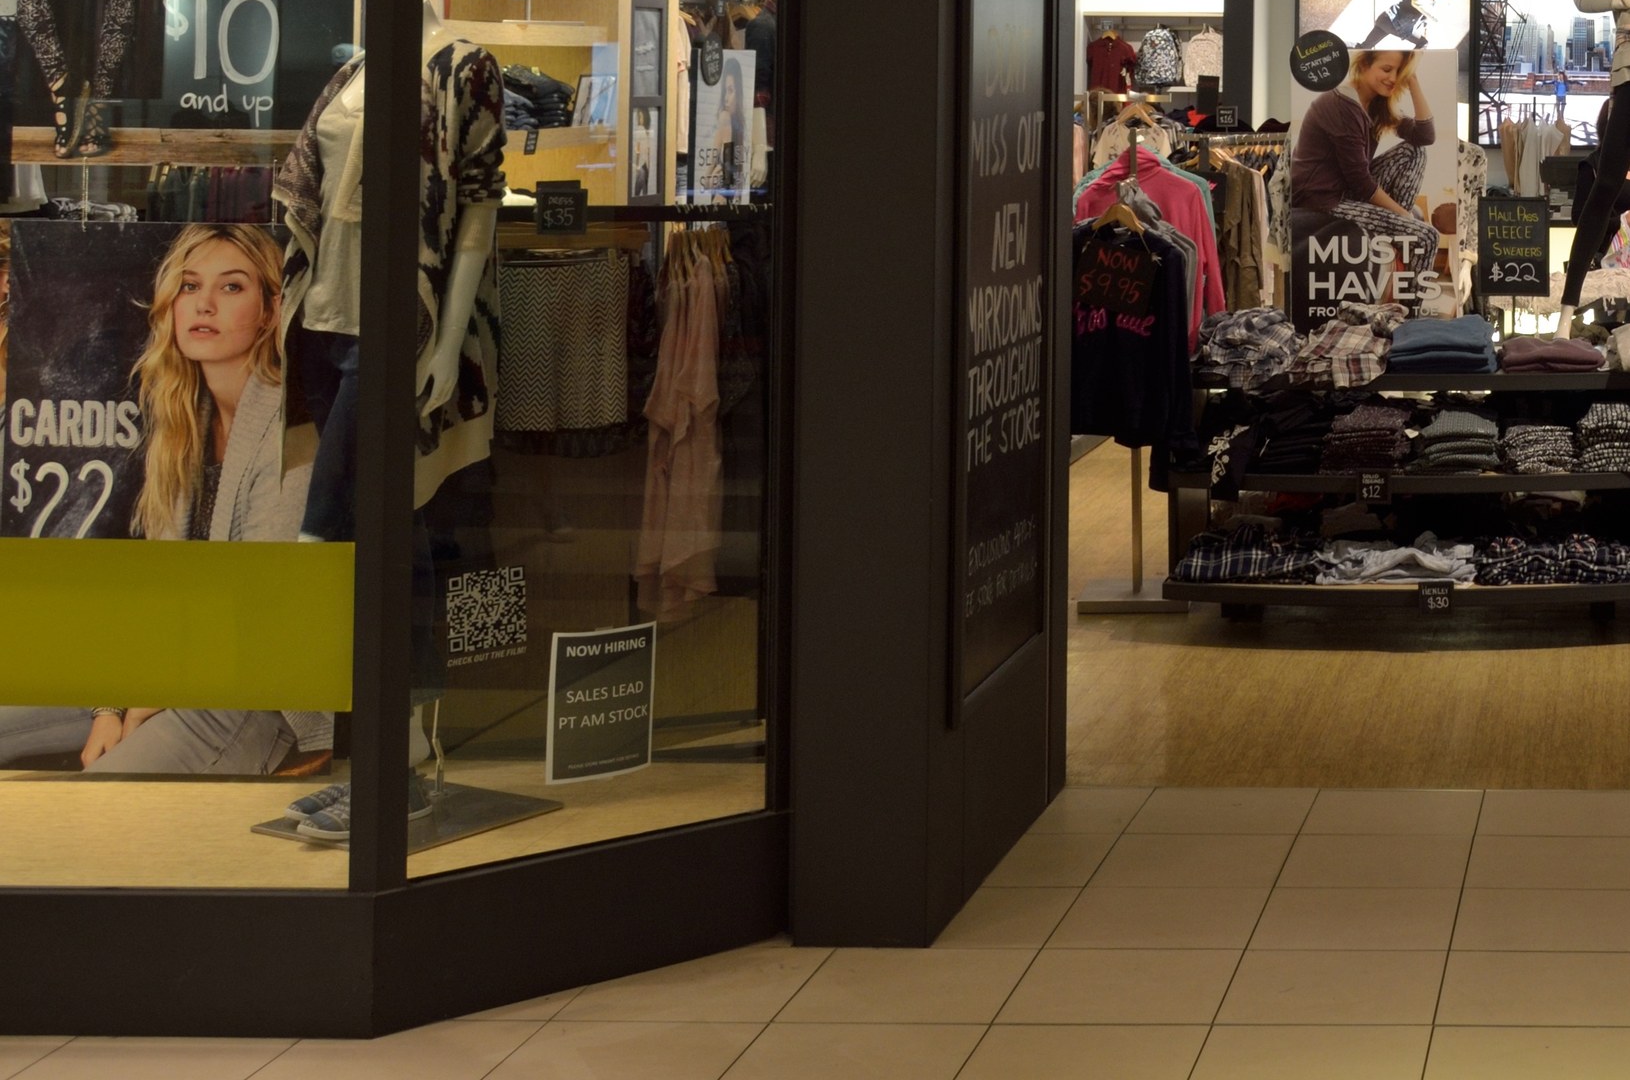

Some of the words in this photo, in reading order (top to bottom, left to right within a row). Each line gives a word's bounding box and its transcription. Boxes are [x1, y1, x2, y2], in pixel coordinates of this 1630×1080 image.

[180, 84, 229, 113] and
[242, 95, 274, 128] up
[971, 112, 1008, 177] MISS
[1017, 110, 1045, 174] OUT
[543, 208, 575, 228] $35
[991, 200, 1028, 273] NEW
[1487, 225, 1533, 239] FLEECE
[1097, 247, 1139, 273] NOW
[1309, 235, 1425, 264] MUST-
[1309, 270, 1442, 300] HAVES
[1488, 261, 1540, 283] $22
[1309, 306, 1339, 318] FRO
[1412, 306, 1439, 317] TOE
[968, 335, 1042, 421] THROUGHOUT
[10, 398, 140, 450] CARDIS
[967, 415, 993, 473] THE
[998, 396, 1041, 454] STORE
[1427, 596, 1449, 610] $30
[566, 644, 601, 657] NOW
[604, 637, 646, 654] HIRING
[566, 686, 608, 703] SALES
[612, 680, 644, 697] LEAD
[558, 716, 577, 730] PT
[580, 713, 604, 728] AM
[609, 704, 648, 724] STOCK
